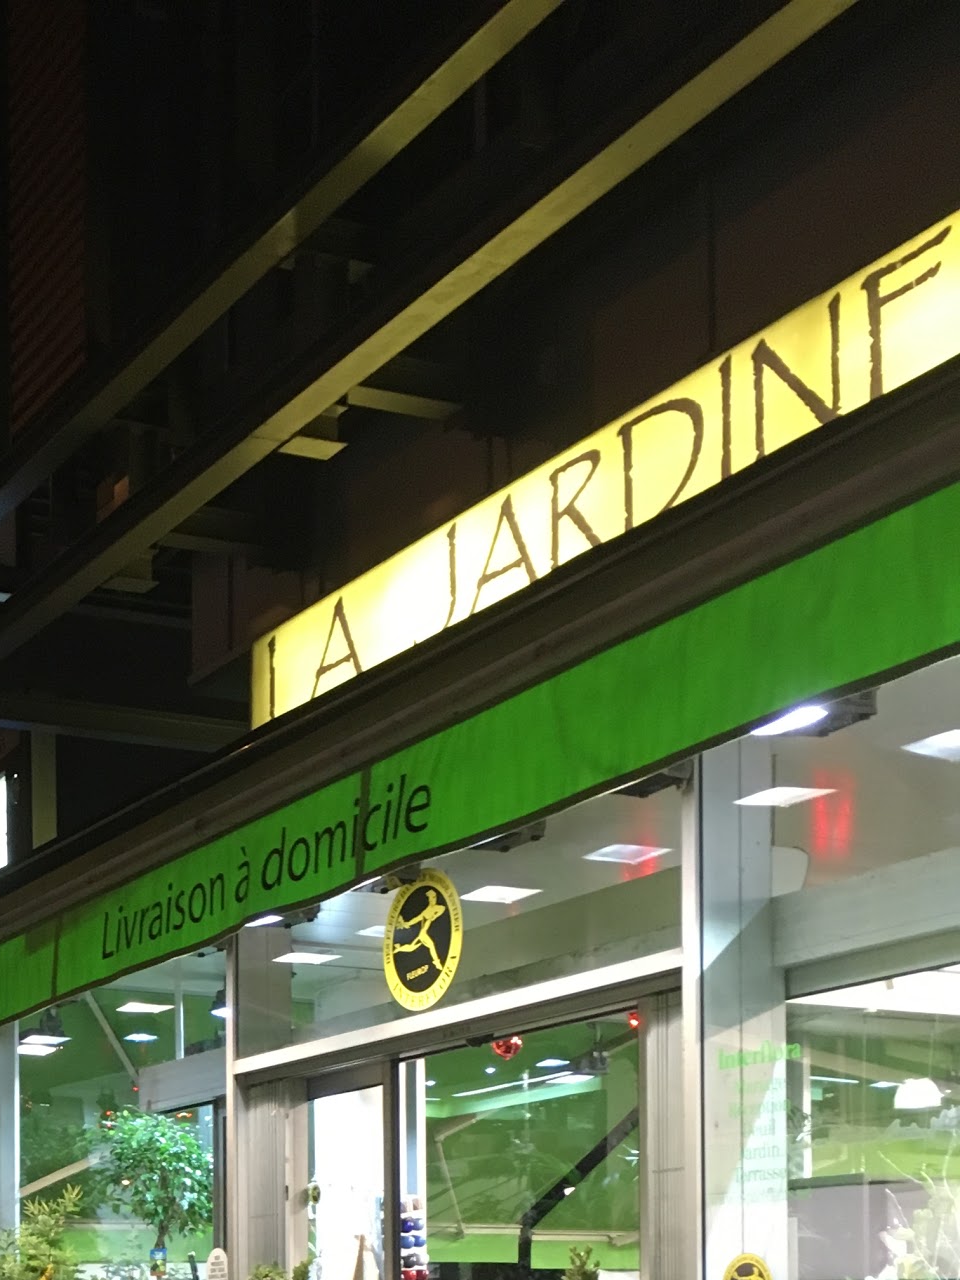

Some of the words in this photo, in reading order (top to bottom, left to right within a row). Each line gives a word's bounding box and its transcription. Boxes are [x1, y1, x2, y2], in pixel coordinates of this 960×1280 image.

[101, 872, 225, 960] Livraison
[235, 846, 251, 903] à
[261, 774, 432, 890] domicile
